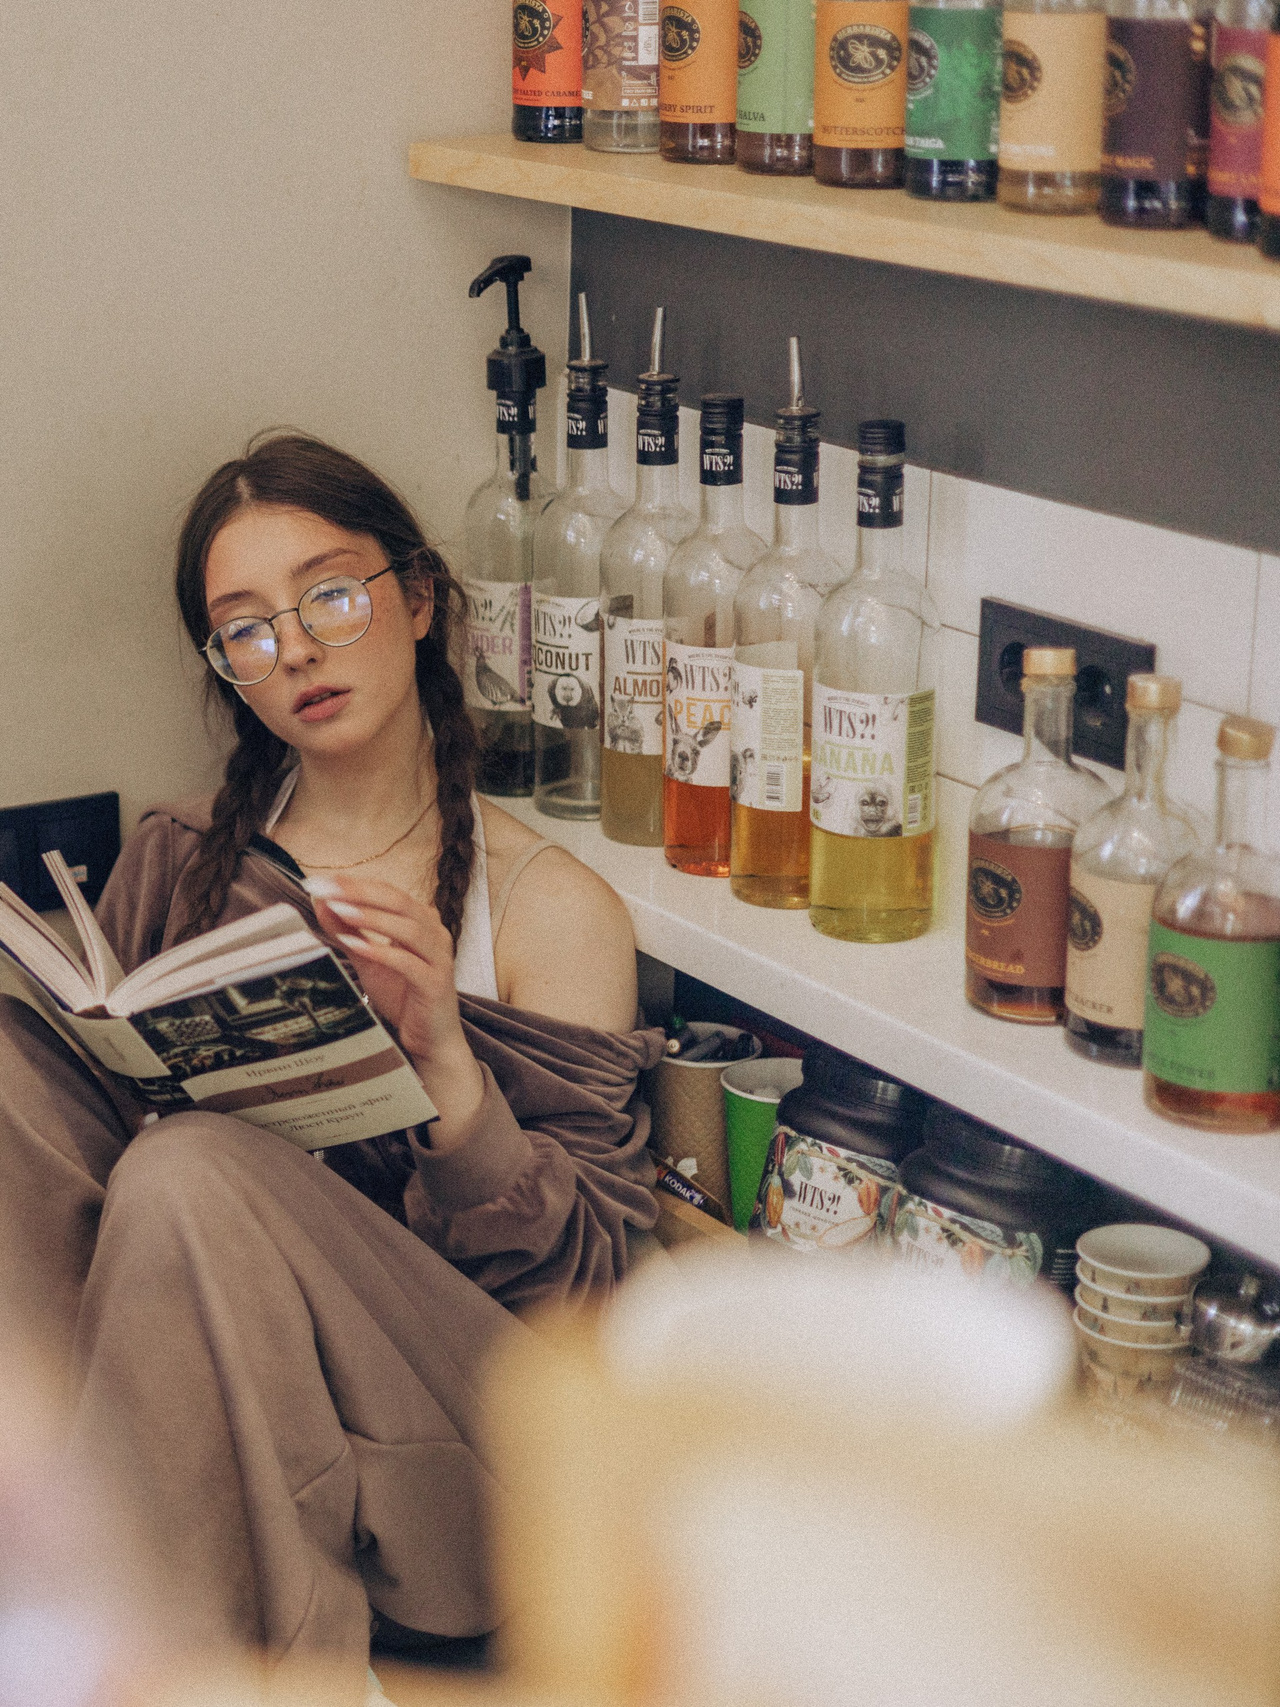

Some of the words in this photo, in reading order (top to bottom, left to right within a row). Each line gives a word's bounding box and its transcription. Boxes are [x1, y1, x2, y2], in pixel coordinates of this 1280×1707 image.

[680, 105, 715, 114] SPIRIT
[703, 453, 735, 471] WTS?!
[624, 638, 662, 666] WTS
[613, 676, 661, 698] ALMO
[684, 662, 732, 693] WTS?
[674, 699, 732, 727] PEAC
[824, 705, 877, 740] WTS?!
[245, 1063, 292, 1078] Ирвин
[294, 1054, 325, 1068] Шоу
[360, 1092, 394, 1109] эфир
[290, 1120, 325, 1132] Люси
[326, 1111, 365, 1125] Краун
[664, 1173, 692, 1200] KODAK
[797, 1180, 841, 1216] WTS?!
